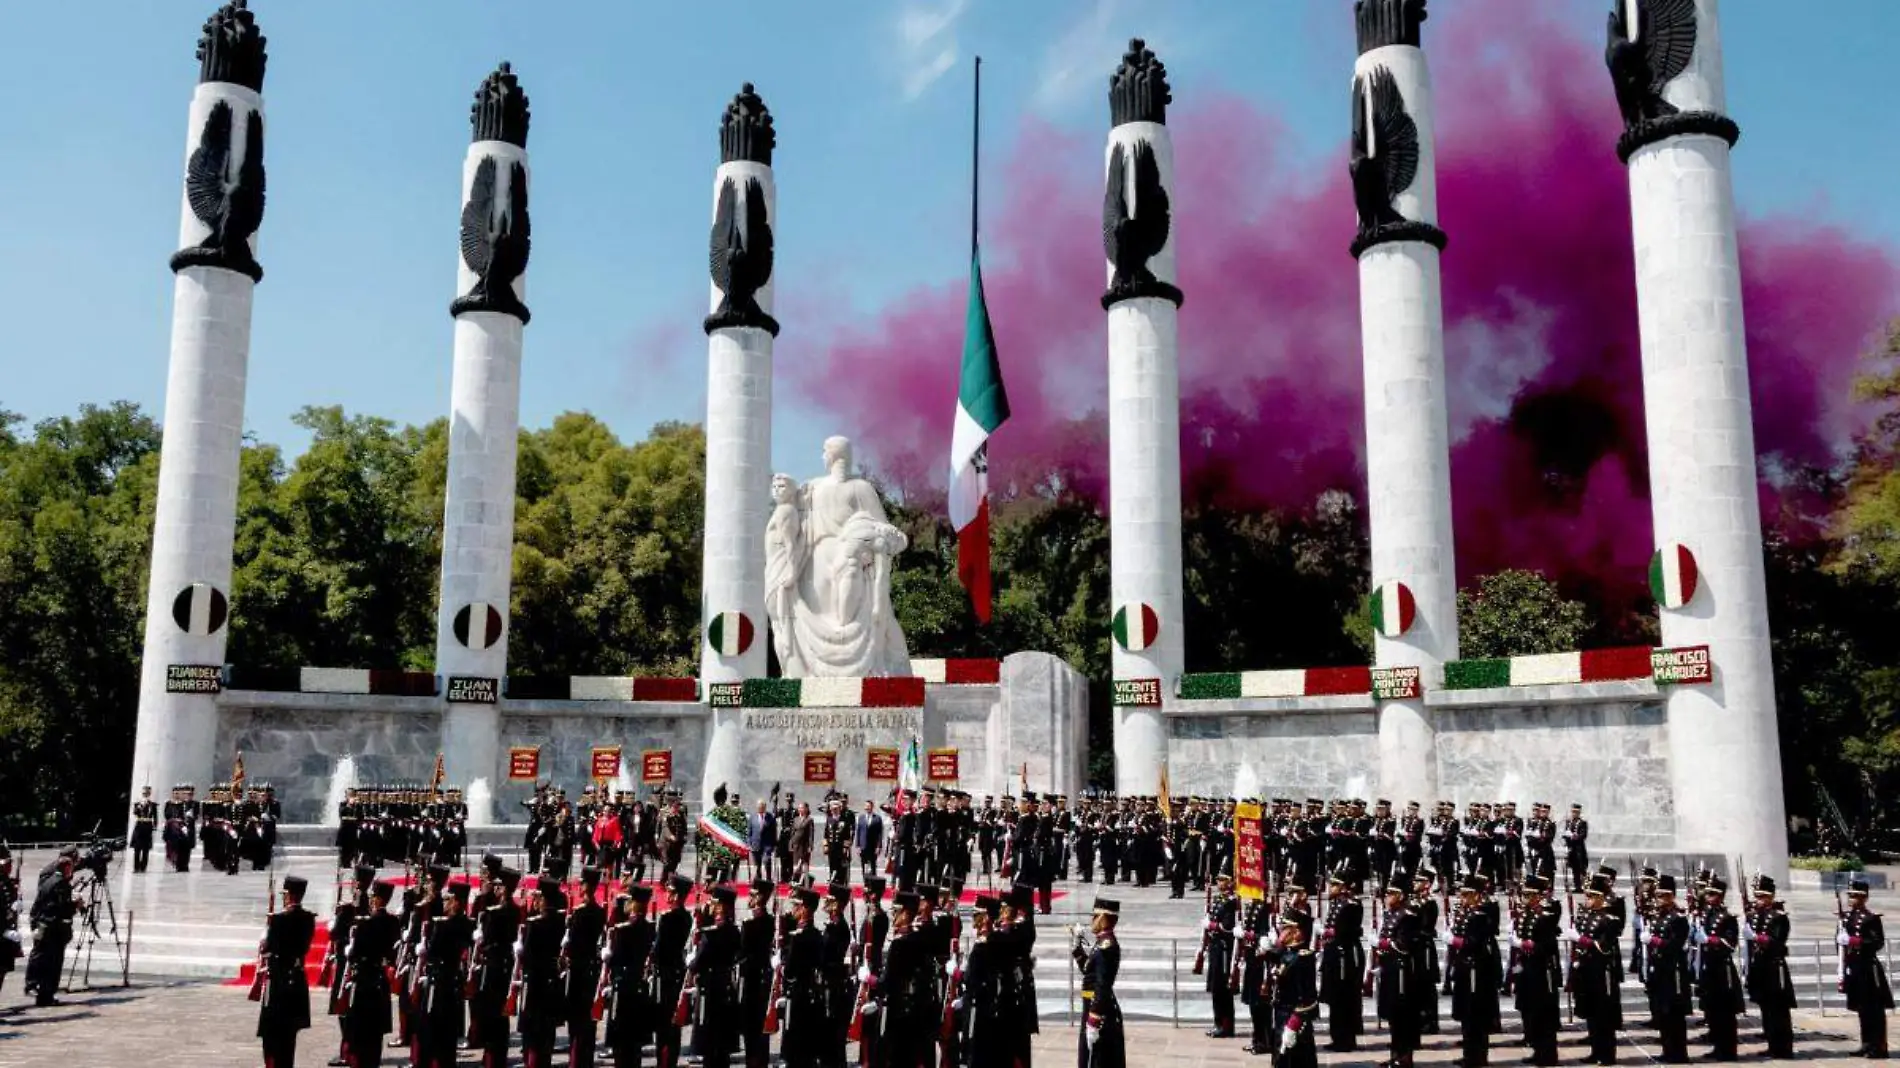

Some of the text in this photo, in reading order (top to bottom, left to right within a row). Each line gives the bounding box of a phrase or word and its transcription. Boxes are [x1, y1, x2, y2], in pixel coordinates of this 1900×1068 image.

[1651, 650, 1707, 666] FRANCISCO
[1372, 669, 1418, 680] FERNANDO
[169, 679, 218, 690] BARRERA
[454, 680, 491, 690] JUAN
[1115, 681, 1157, 692] VICENTE
[1374, 678, 1415, 689] MONTES
[450, 690, 495, 701] ESCUTIA
[1392, 687, 1414, 697] OCA
[756, 715, 775, 729] LOS
[859, 715, 873, 729] LA
[876, 714, 919, 729] PATRIA
